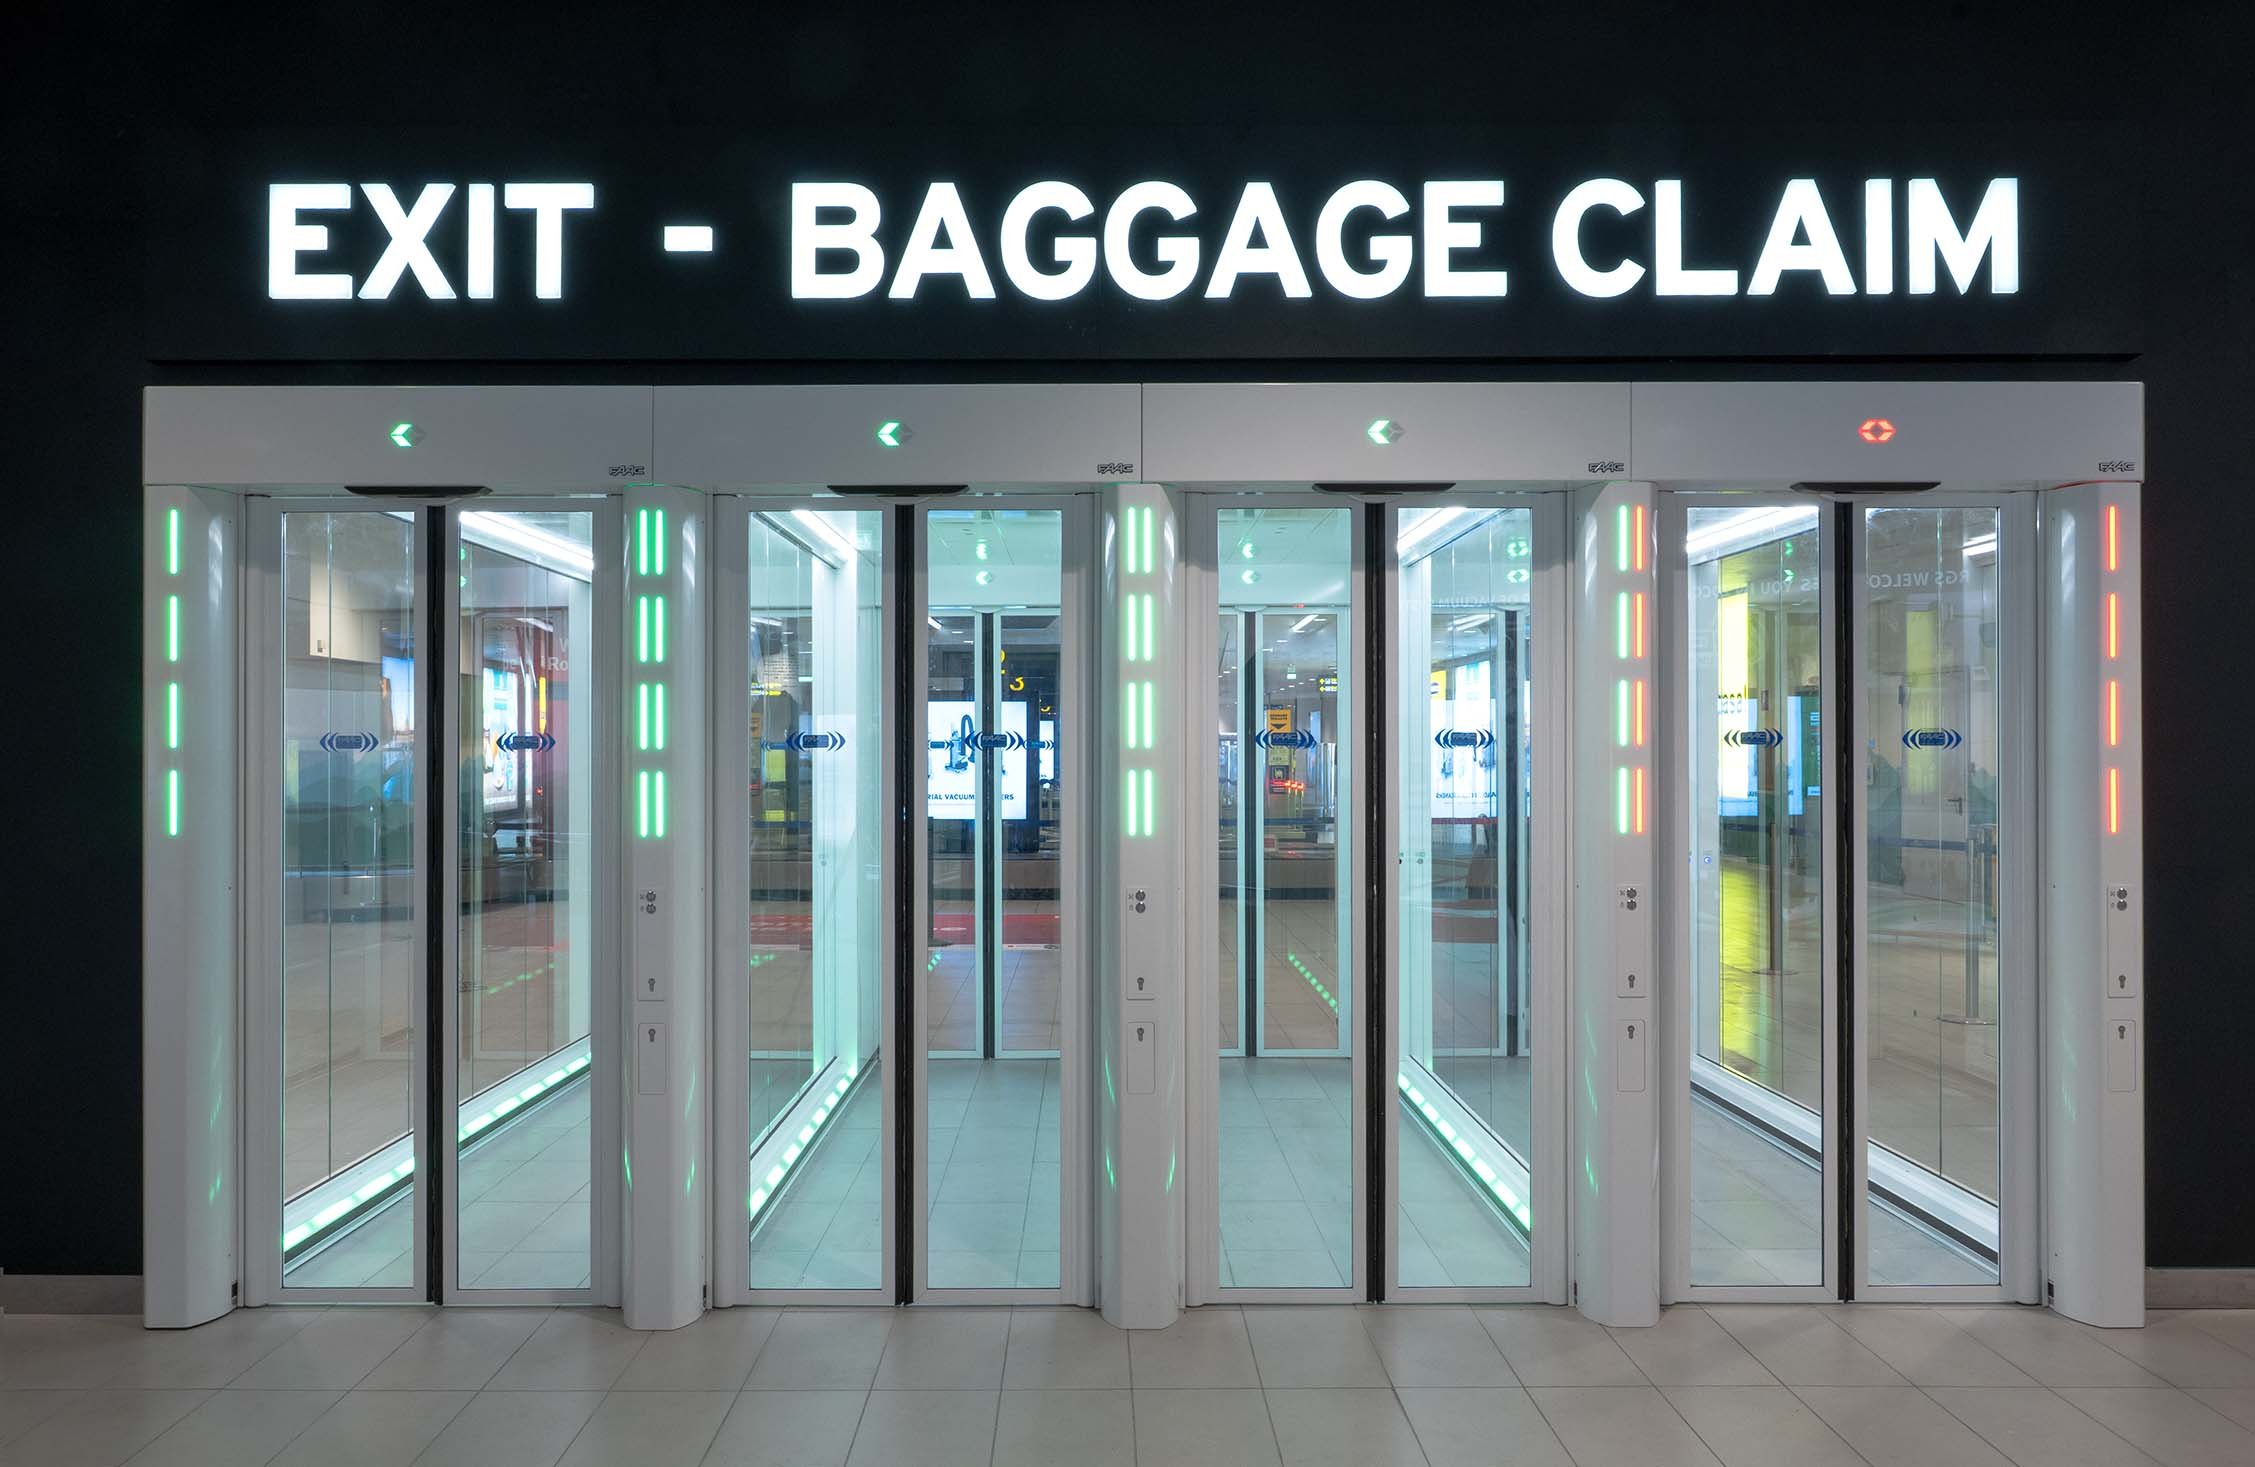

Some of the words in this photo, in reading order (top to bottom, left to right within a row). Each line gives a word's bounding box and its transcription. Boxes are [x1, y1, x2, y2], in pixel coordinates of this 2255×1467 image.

[268, 183, 595, 300] EXIT
[664, 226, 714, 252] -
[791, 180, 1508, 301] BAGGAGE
[1551, 178, 2020, 298] CLAIM
[609, 464, 645, 476] FAAC
[1097, 462, 1134, 474] FAAC
[1588, 462, 1625, 473] FAAC
[2098, 461, 2136, 473] FAAC
[944, 793, 976, 801] VACUUM
